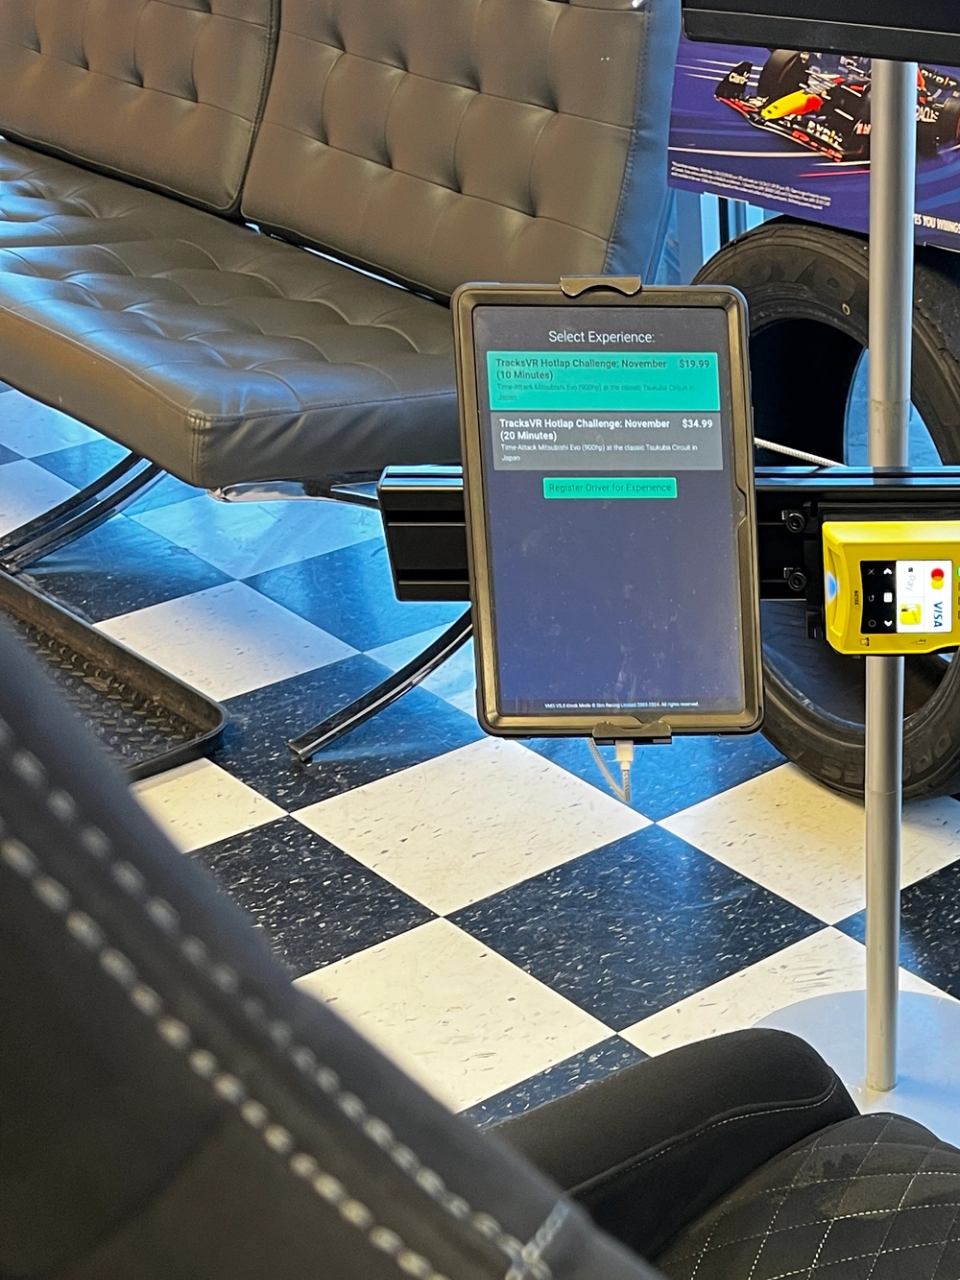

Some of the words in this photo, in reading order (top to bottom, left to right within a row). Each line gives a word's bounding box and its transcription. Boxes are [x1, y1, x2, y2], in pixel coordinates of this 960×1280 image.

[922, 215, 937, 229] YOU
[548, 330, 585, 343] Select
[588, 330, 656, 345] Experience:
[496, 358, 539, 367] TracksVR
[540, 358, 571, 368] Hotlap
[572, 358, 619, 369] Challenge:
[621, 359, 667, 368] November
[679, 359, 710, 369] $19.99
[496, 370, 512, 381] (10
[513, 370, 553, 381] Minutes)
[499, 418, 543, 428] TracksVR
[544, 418, 574, 430] Hotlap
[575, 418, 623, 430] Challenge:
[624, 419, 670, 428] November
[682, 418, 713, 429] $34.99
[500, 430, 515, 442] (20
[517, 430, 557, 442] Minutes)
[933, 601, 944, 628] VISA
